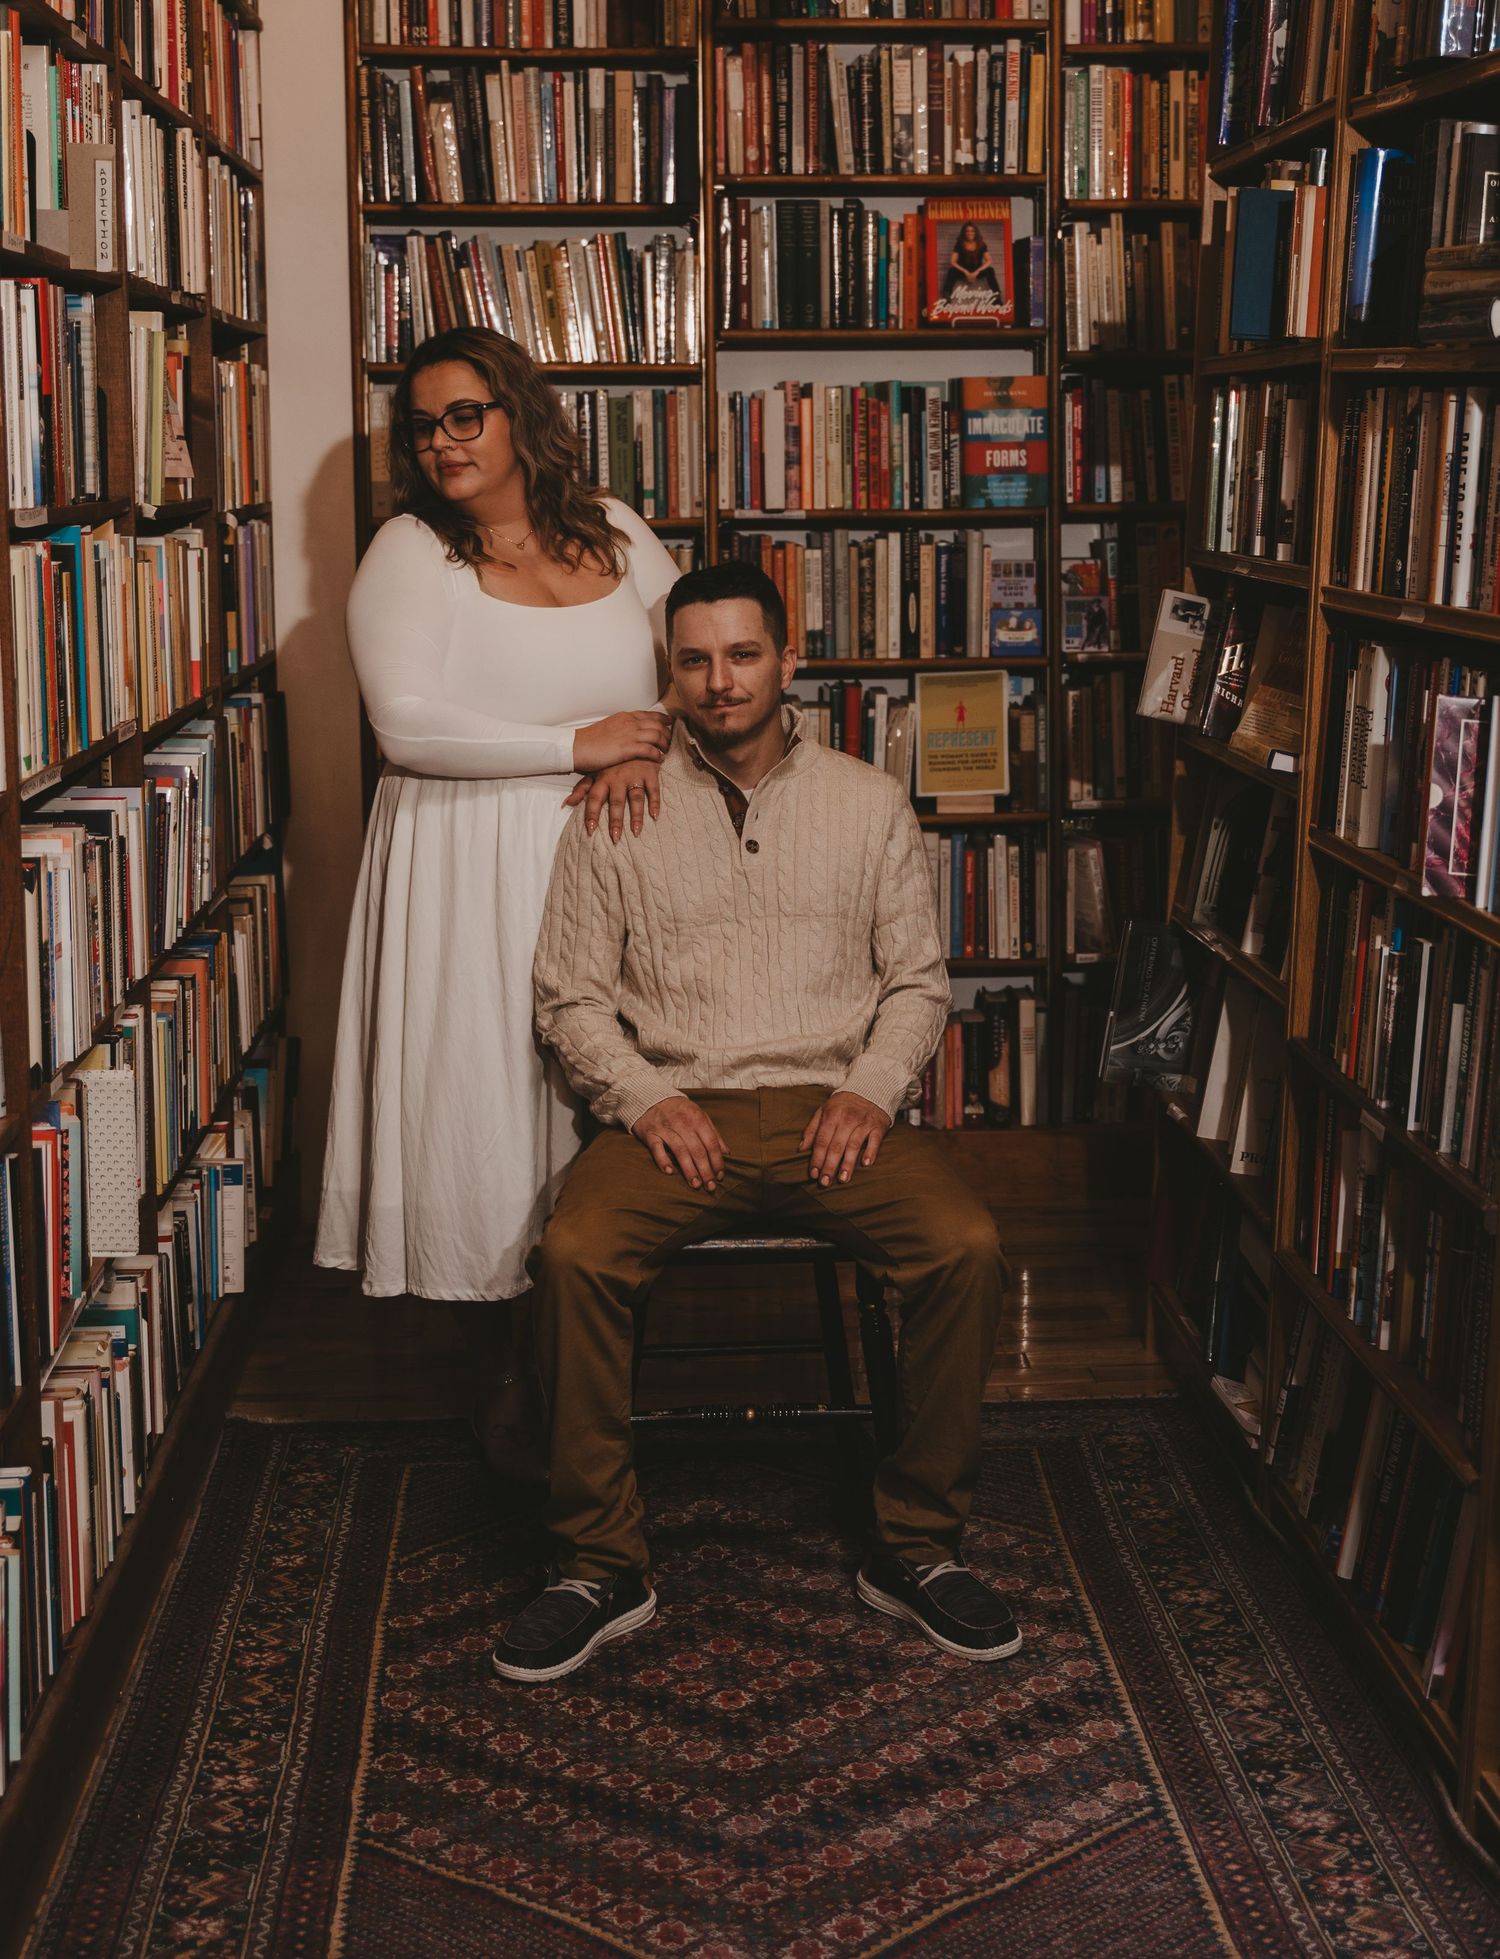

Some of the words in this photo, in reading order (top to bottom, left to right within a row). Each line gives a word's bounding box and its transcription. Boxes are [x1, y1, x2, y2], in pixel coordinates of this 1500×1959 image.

[1008, 52, 1020, 102] AWAKENING
[100, 168, 108, 261] ADDICTION
[928, 201, 964, 220] GLORIA
[966, 200, 1010, 220] STEINEM
[932, 299, 974, 317] Beyond
[975, 299, 1013, 315] Words
[951, 285, 999, 302] Moving
[859, 398, 867, 455] MATERIAL
[929, 398, 940, 428] WOMEN
[967, 416, 1045, 435] IMMACULATE
[929, 431, 940, 450] WHO
[929, 452, 940, 472] WON
[985, 449, 1027, 468] FORMS
[859, 459, 867, 492] GIRLS
[1399, 446, 1411, 528] Speechless
[1456, 483, 1466, 502] TO
[1160, 655, 1185, 716] Harvard
[927, 731, 997, 748] REPRESENT
[1341, 709, 1352, 770] Educated
[1350, 705, 1363, 784] Educated
[1360, 709, 1374, 790] Educated
[1139, 993, 1150, 1022] ATHENA
